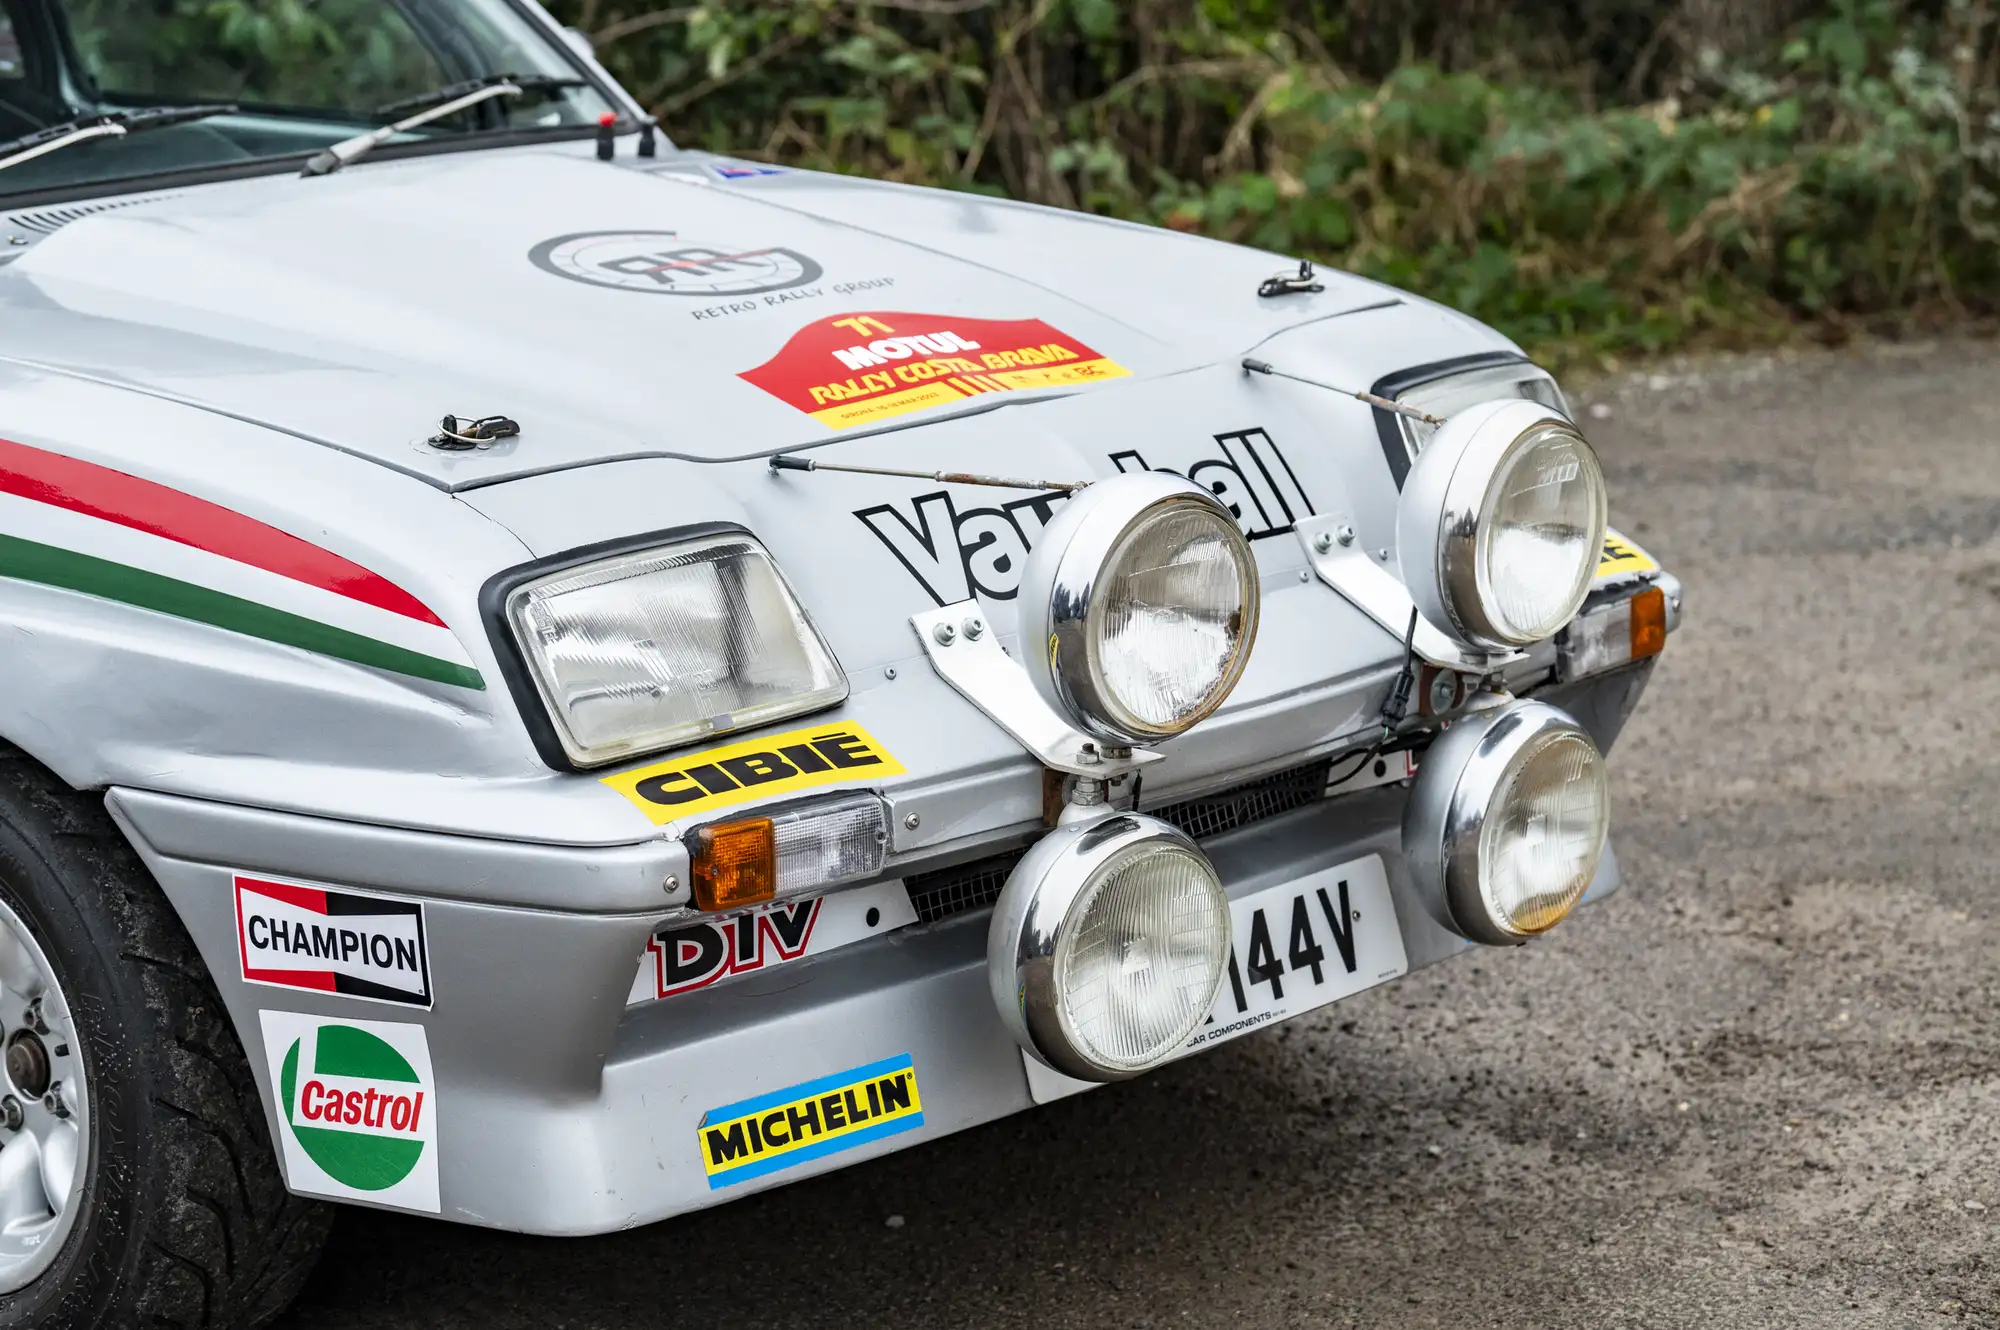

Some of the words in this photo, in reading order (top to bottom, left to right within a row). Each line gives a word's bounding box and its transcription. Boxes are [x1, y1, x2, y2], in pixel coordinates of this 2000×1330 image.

[691, 300, 757, 320] RETRO
[764, 286, 824, 306] RALLY
[833, 276, 895, 295] GROUP
[832, 316, 895, 337] 71
[832, 331, 981, 370] MOTUL
[808, 371, 897, 405] RALLY
[893, 357, 987, 383] COSTA
[980, 343, 1080, 370] BRAVA
[249, 915, 418, 972] CHAMPION
[1208, 1011, 1272, 1040] COMPONENTS
[301, 1080, 425, 1133] Castrol
[706, 1073, 912, 1166] MICHELIN
